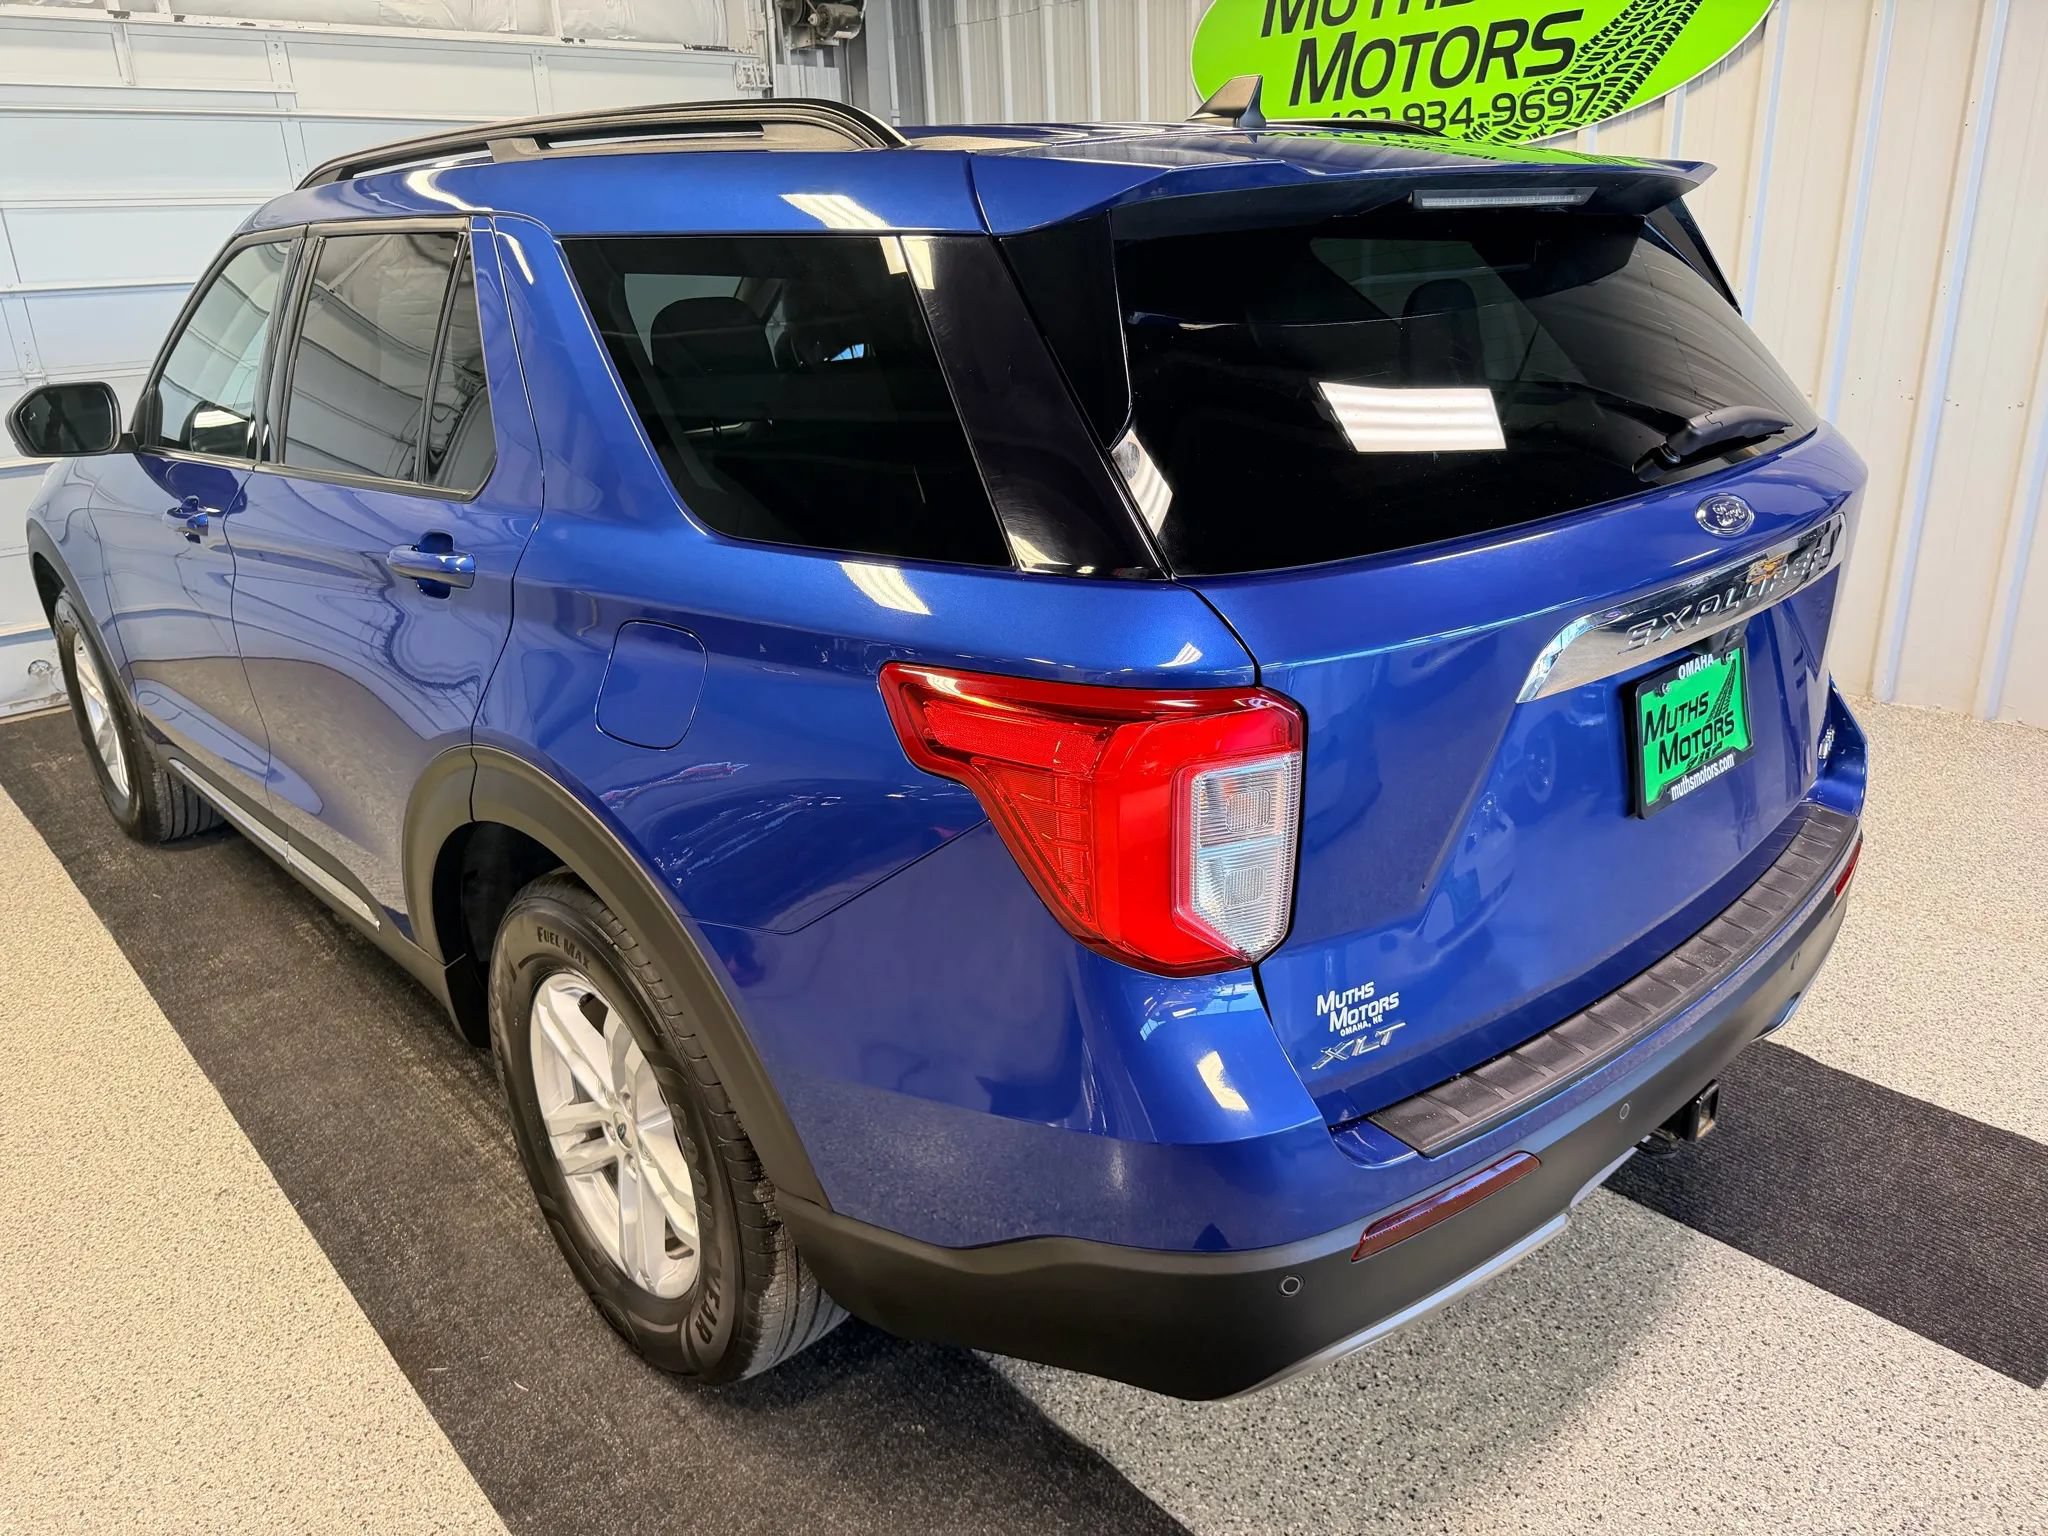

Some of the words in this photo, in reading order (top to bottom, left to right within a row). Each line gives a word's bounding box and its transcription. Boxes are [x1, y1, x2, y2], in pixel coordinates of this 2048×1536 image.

[1289, 9, 1584, 106] MOTORS
[1678, 654, 1714, 680] OMAHA
[1644, 691, 1709, 746] MUTHS
[1659, 711, 1735, 774] MOTORS
[1670, 753, 1735, 800] muthsmotors.com
[537, 926, 561, 949] FUEL
[563, 938, 590, 970] MAX
[1316, 981, 1375, 1016] MUTHS
[1329, 992, 1400, 1033] MOTORS
[1312, 1022, 1406, 1070] XLT
